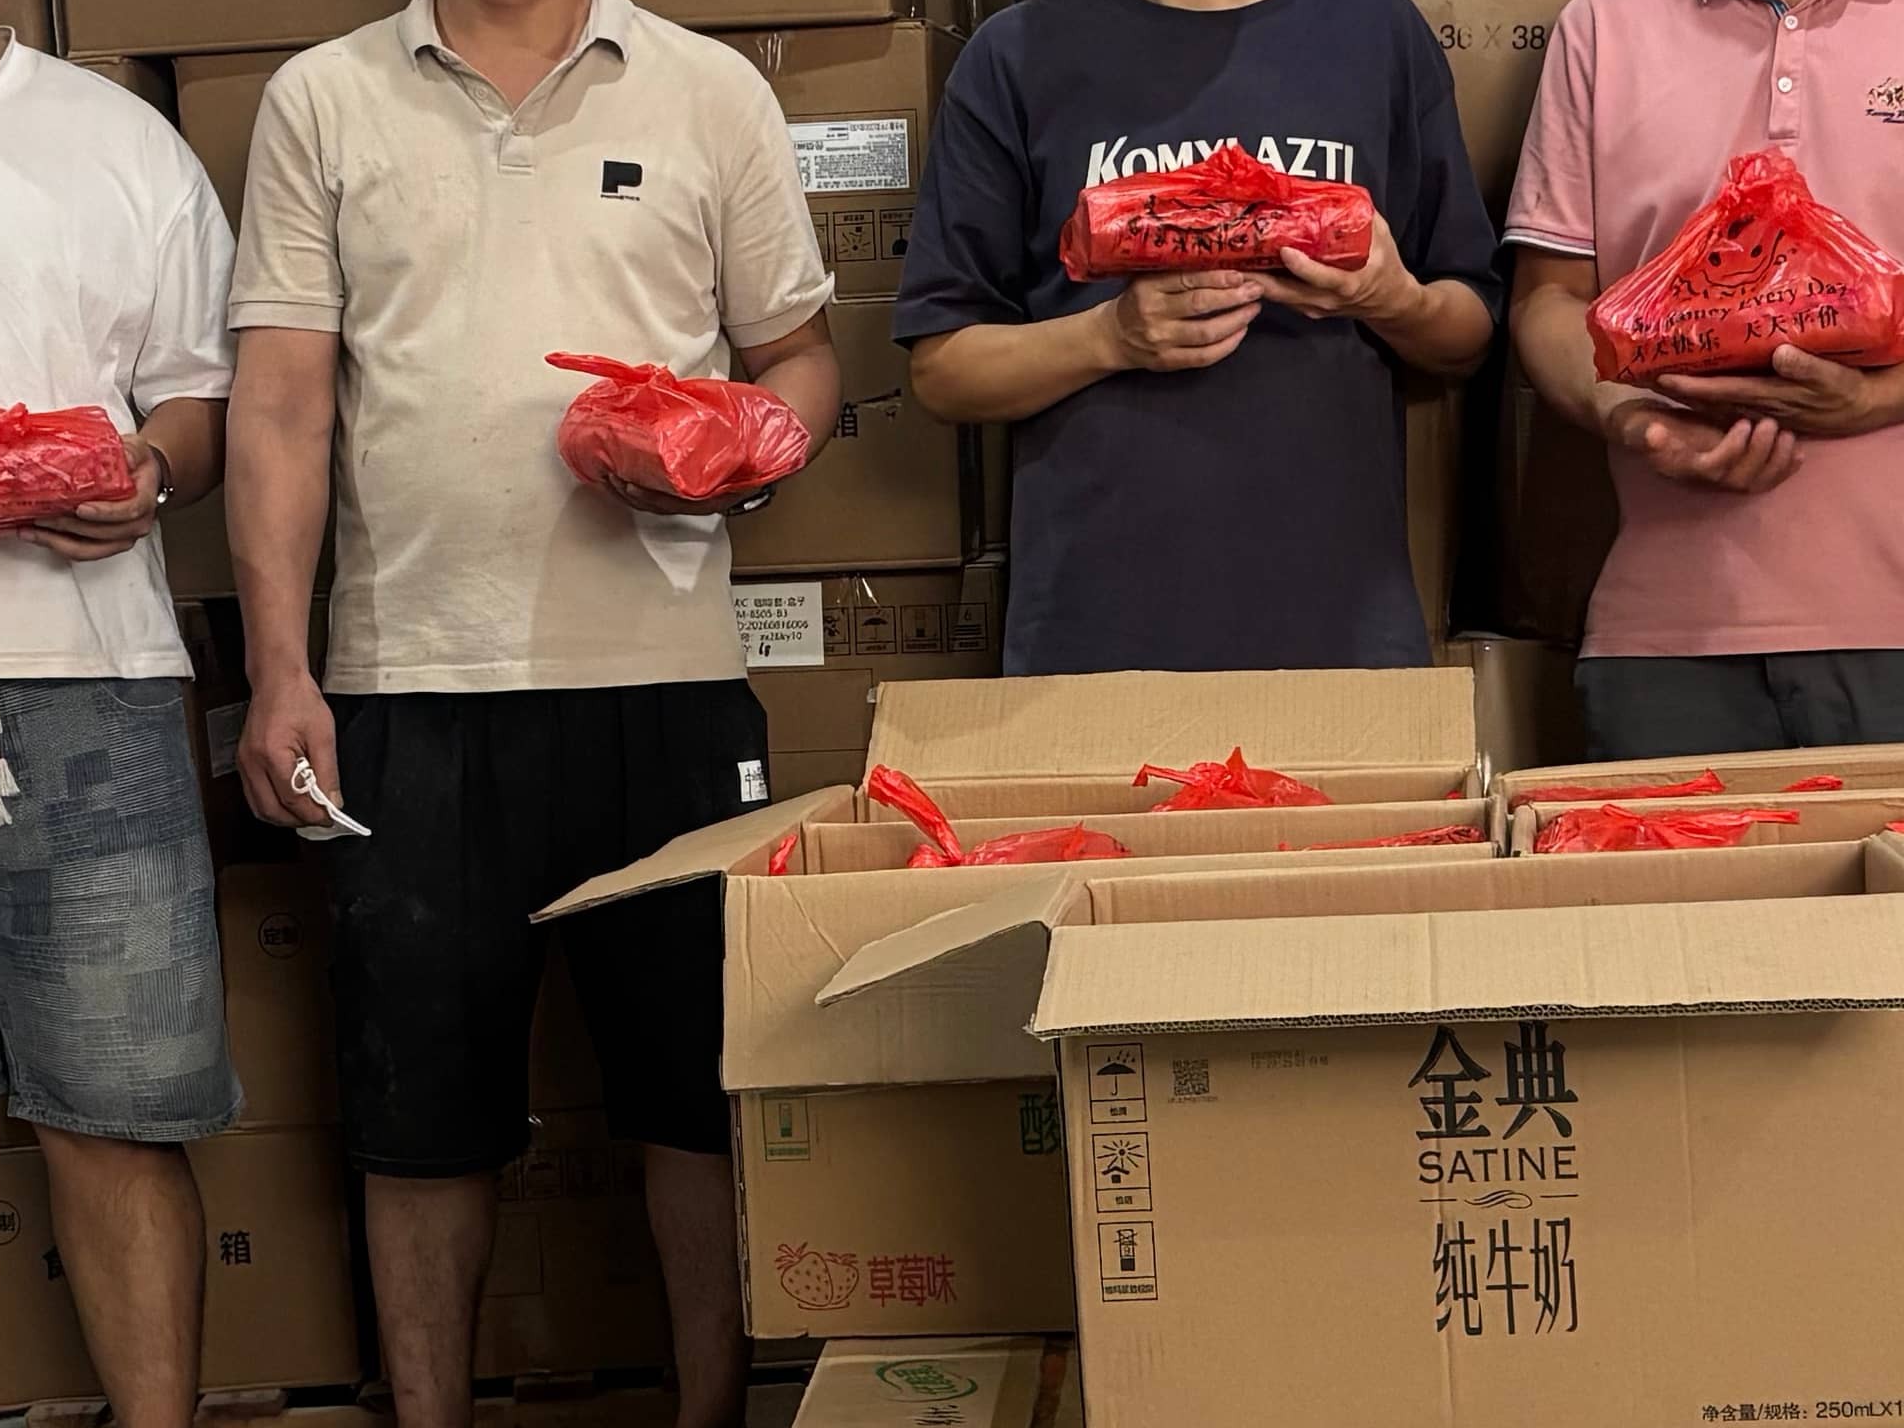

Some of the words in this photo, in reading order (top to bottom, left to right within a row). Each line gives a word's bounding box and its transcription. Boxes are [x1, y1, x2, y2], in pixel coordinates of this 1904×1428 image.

[1511, 24, 1546, 50] 38
[1408, 1020, 1580, 1142] 金典
[1416, 1145, 1580, 1185] SATINE
[866, 1254, 959, 1307] 草莓味
[1432, 1217, 1580, 1336] 纯牛奶
